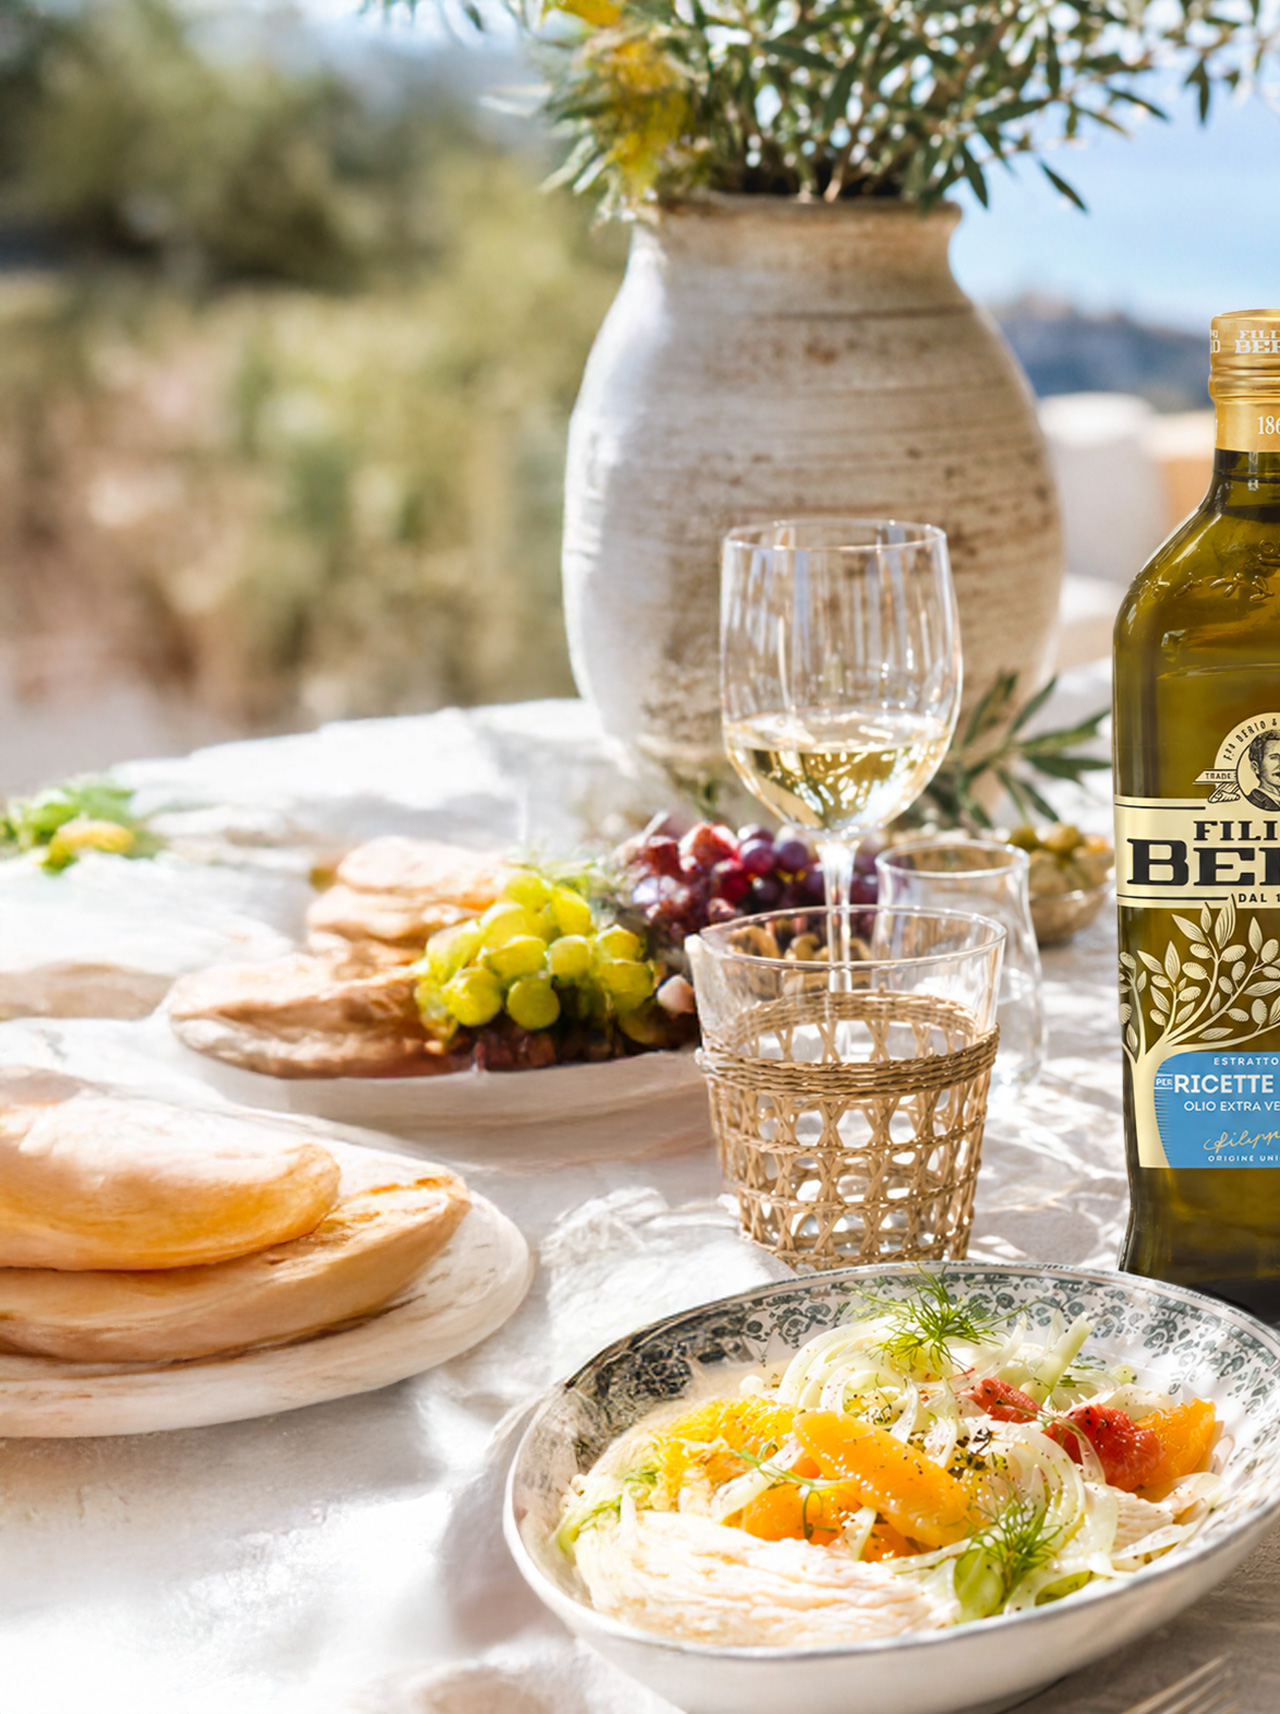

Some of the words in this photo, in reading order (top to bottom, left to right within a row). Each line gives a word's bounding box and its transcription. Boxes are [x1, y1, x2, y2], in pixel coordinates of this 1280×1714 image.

[1205, 772, 1231, 780] TRADE
[1238, 893, 1267, 903] DAL
[1213, 1057, 1279, 1066] ESTRATTO
[1155, 1077, 1173, 1086] PER
[1174, 1074, 1274, 1094] RICETTE
[1184, 1101, 1217, 1112] OLIO
[1220, 1101, 1262, 1112] EXTRA
